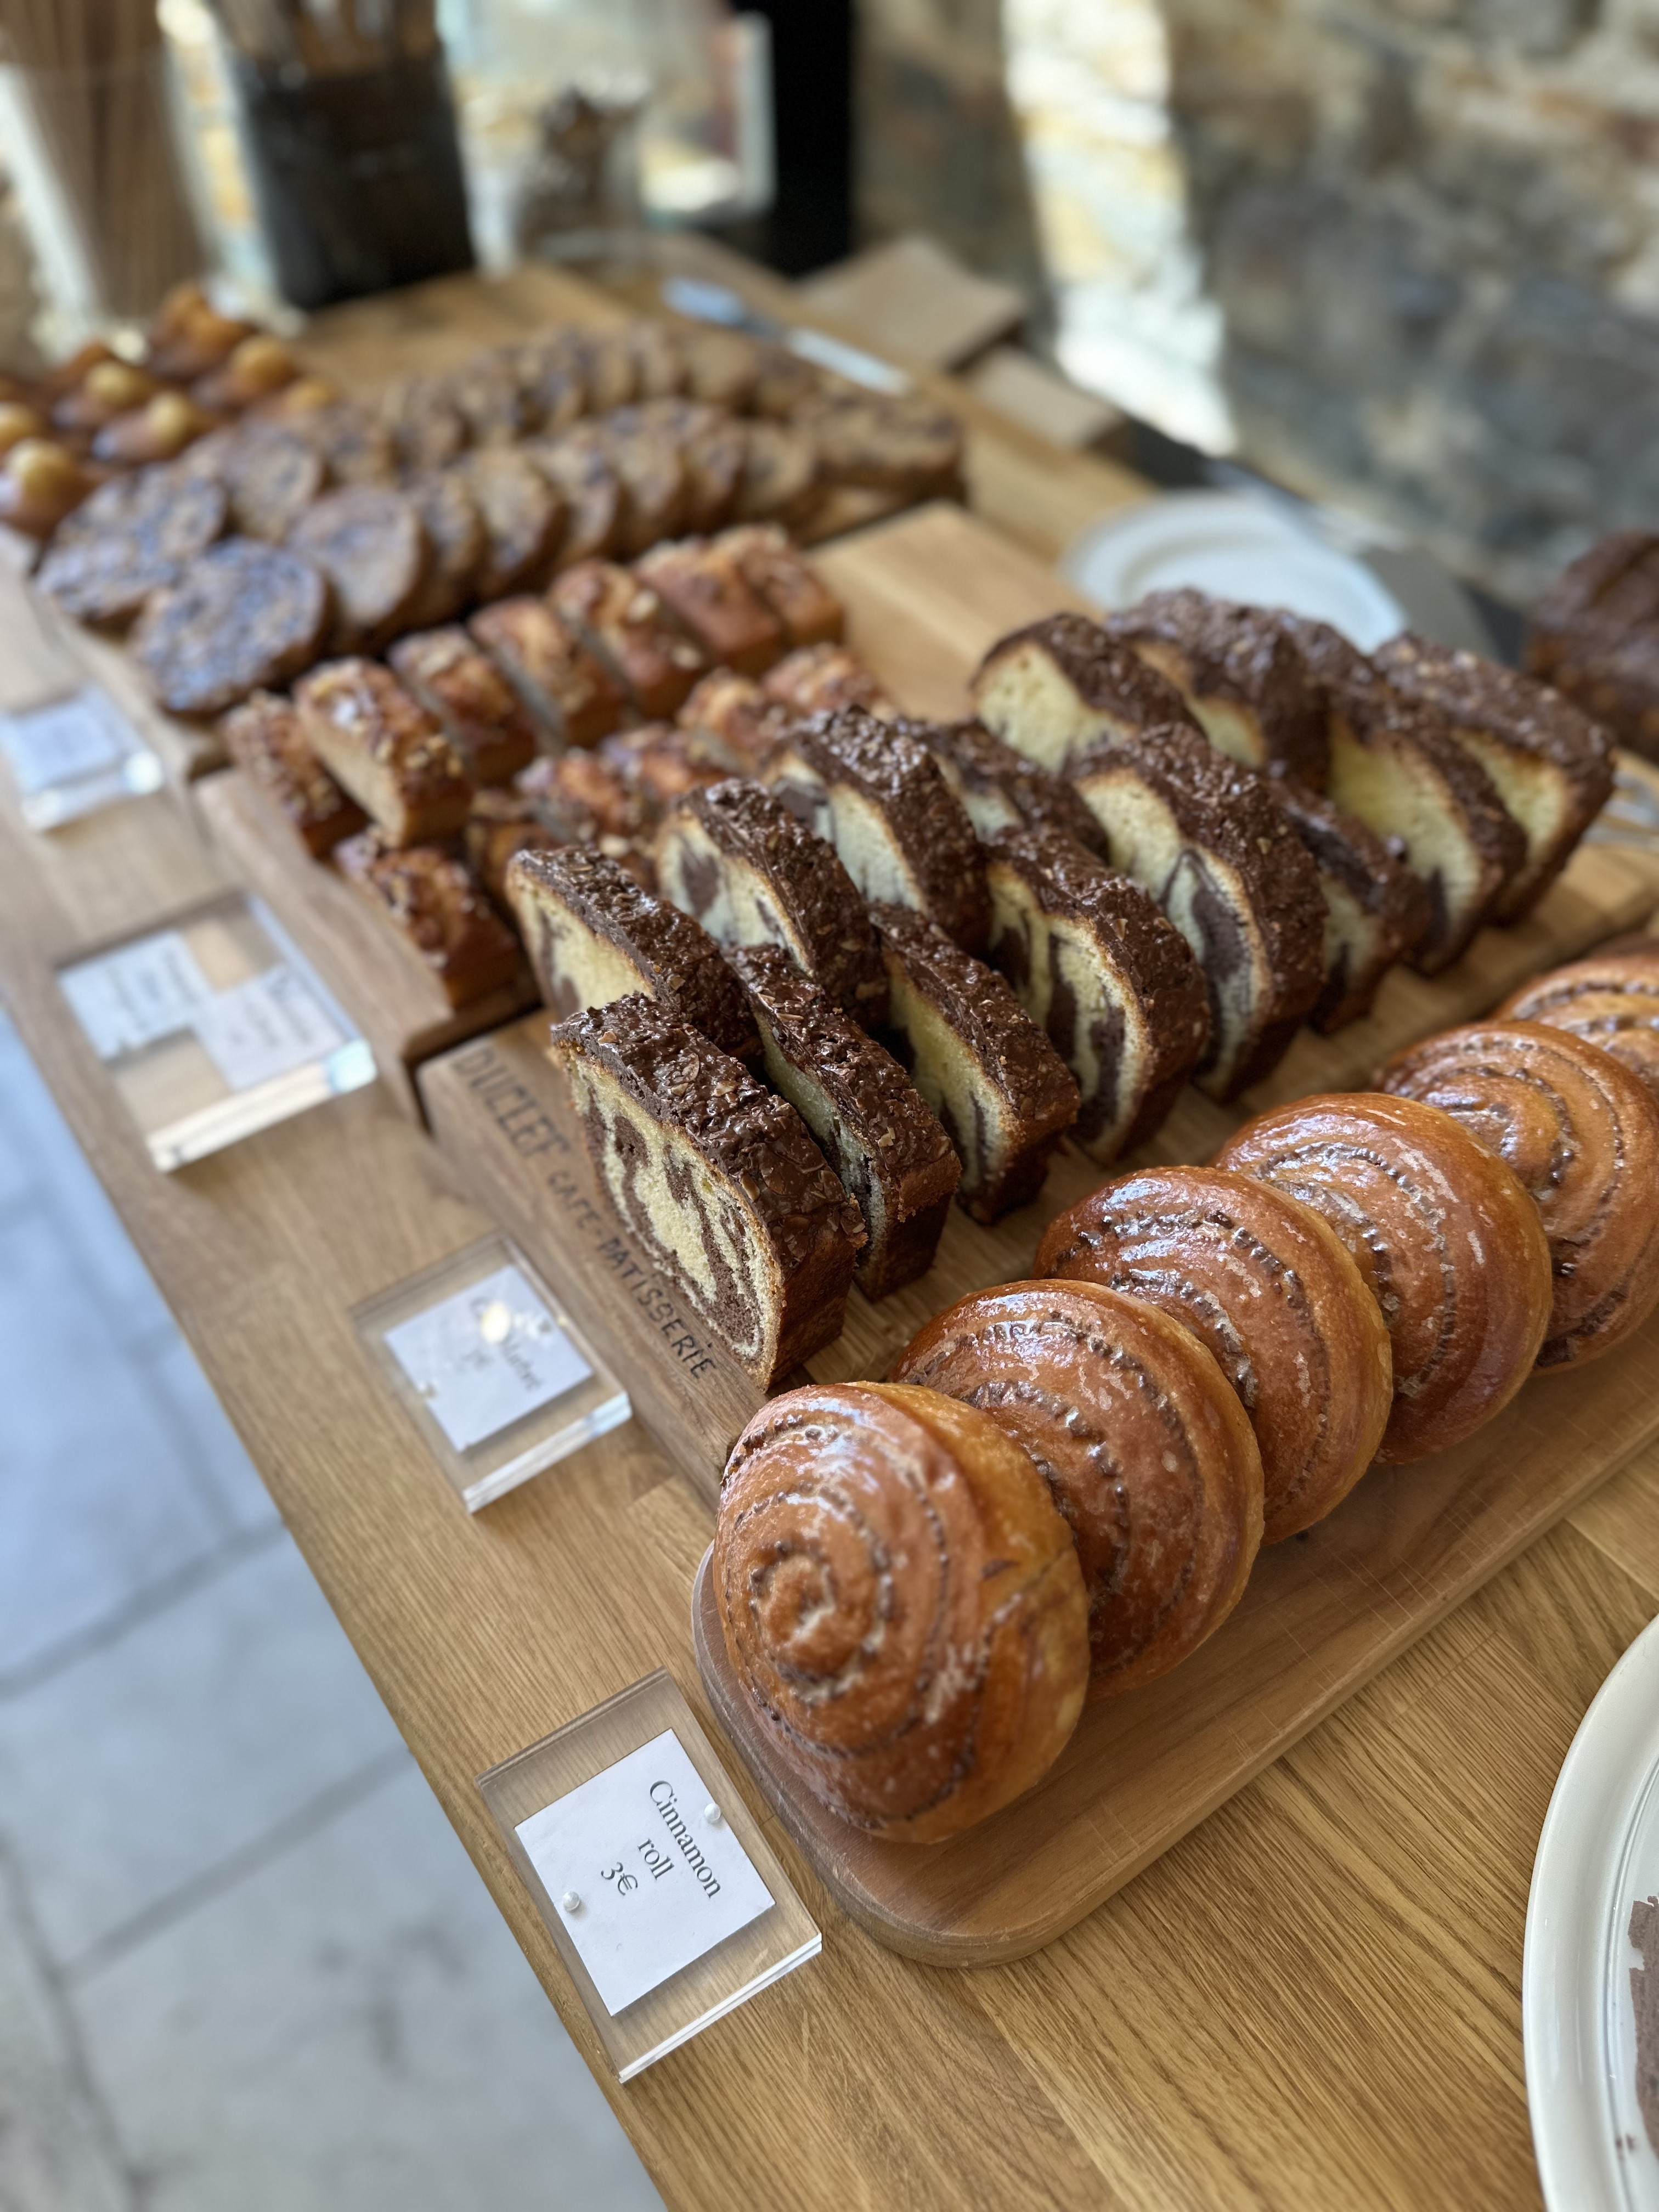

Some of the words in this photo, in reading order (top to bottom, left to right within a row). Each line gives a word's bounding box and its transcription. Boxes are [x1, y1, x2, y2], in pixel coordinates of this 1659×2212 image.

[637, 1838, 675, 1880] roll
[650, 1780, 721, 1899] Cinnamon
[601, 1861, 638, 1896] 3€
